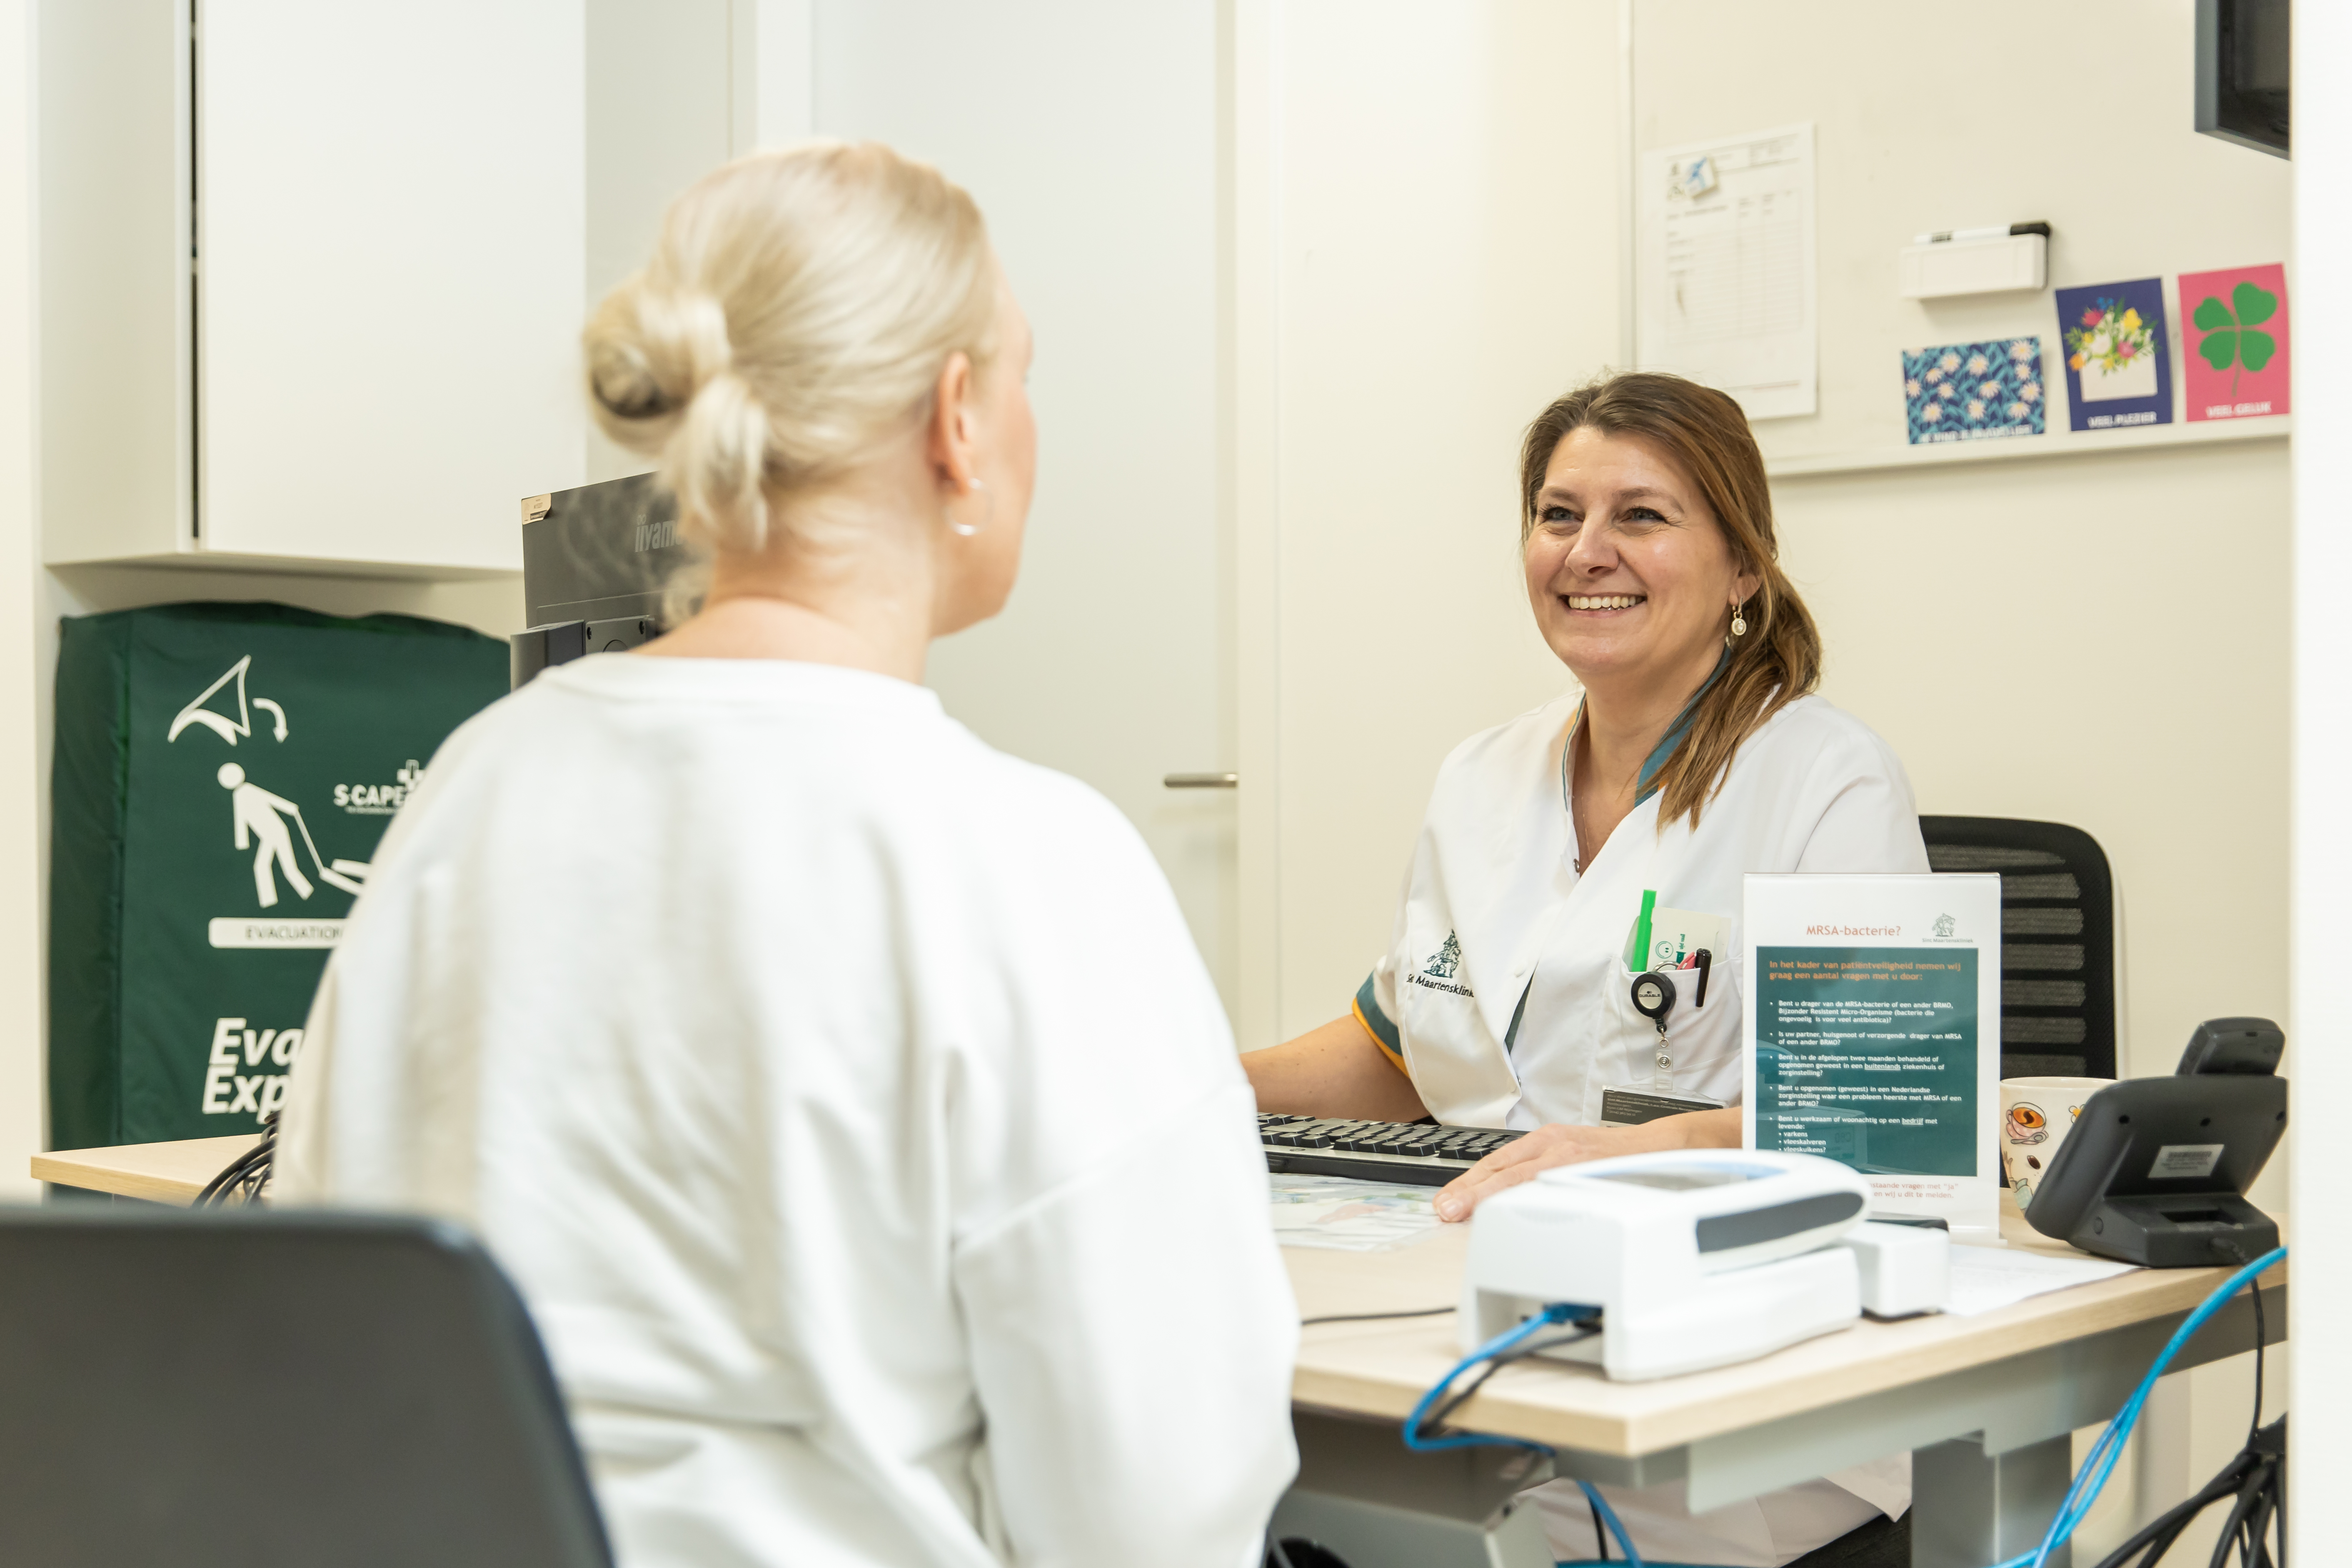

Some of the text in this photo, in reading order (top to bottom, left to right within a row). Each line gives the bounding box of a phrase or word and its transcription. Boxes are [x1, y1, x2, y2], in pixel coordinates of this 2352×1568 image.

[1807, 925, 1900, 936] MRSA-bacterie?
[1947, 963, 1960, 971] wij
[1902, 1183, 1925, 1192] vragen
